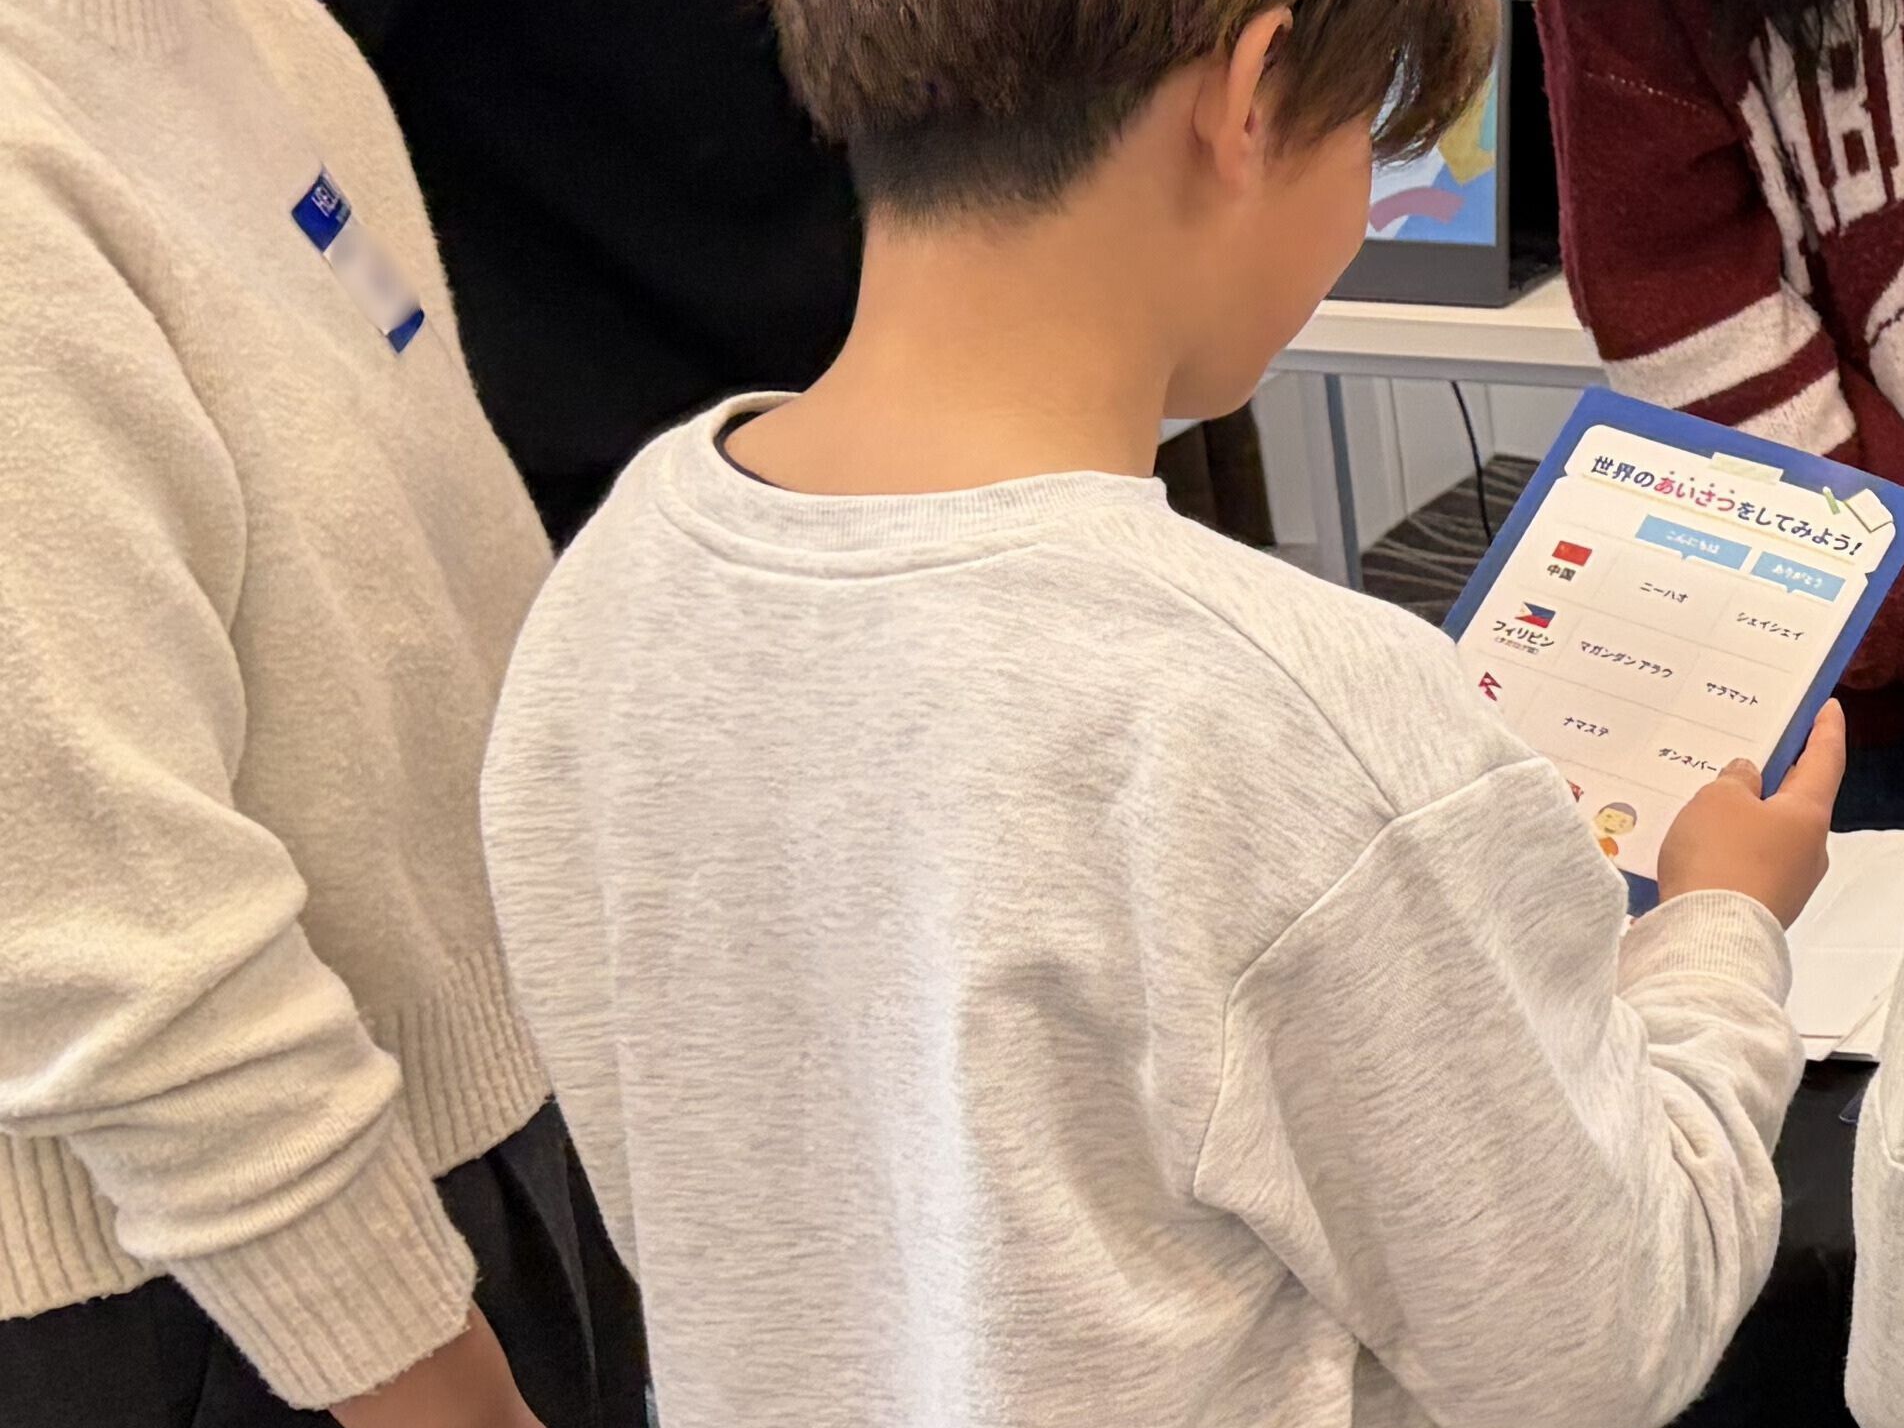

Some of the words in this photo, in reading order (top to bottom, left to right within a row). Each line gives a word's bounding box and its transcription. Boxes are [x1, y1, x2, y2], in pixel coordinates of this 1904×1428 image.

[1592, 455, 1864, 558] 世界のあいさつをしてみよう!
[1546, 562, 1577, 582] 中国
[1639, 581, 1689, 604] ニーハオ
[1562, 715, 1610, 738] ナマステ
[1657, 746, 1718, 773] ダンネバー
